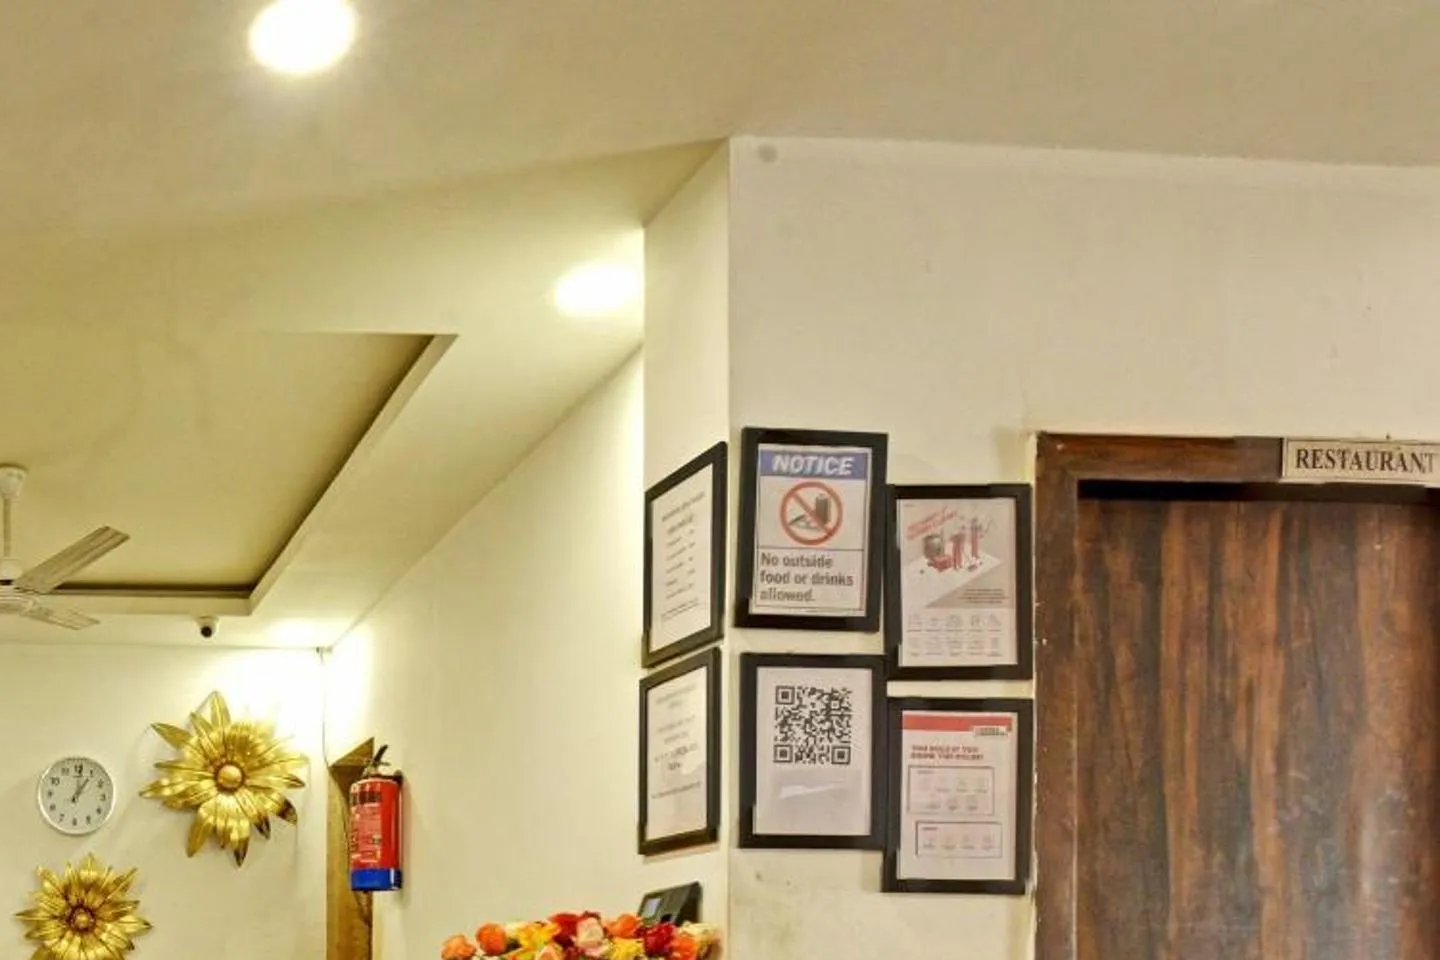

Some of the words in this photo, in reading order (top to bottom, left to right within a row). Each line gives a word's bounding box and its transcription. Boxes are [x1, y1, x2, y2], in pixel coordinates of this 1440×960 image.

[771, 453, 855, 476] NOTICE
[1295, 448, 1434, 473] RESTAURANT
[760, 552, 779, 566] No
[782, 554, 834, 569] outside
[760, 570, 790, 585] food
[794, 575, 809, 586] or
[811, 573, 854, 587] drinks
